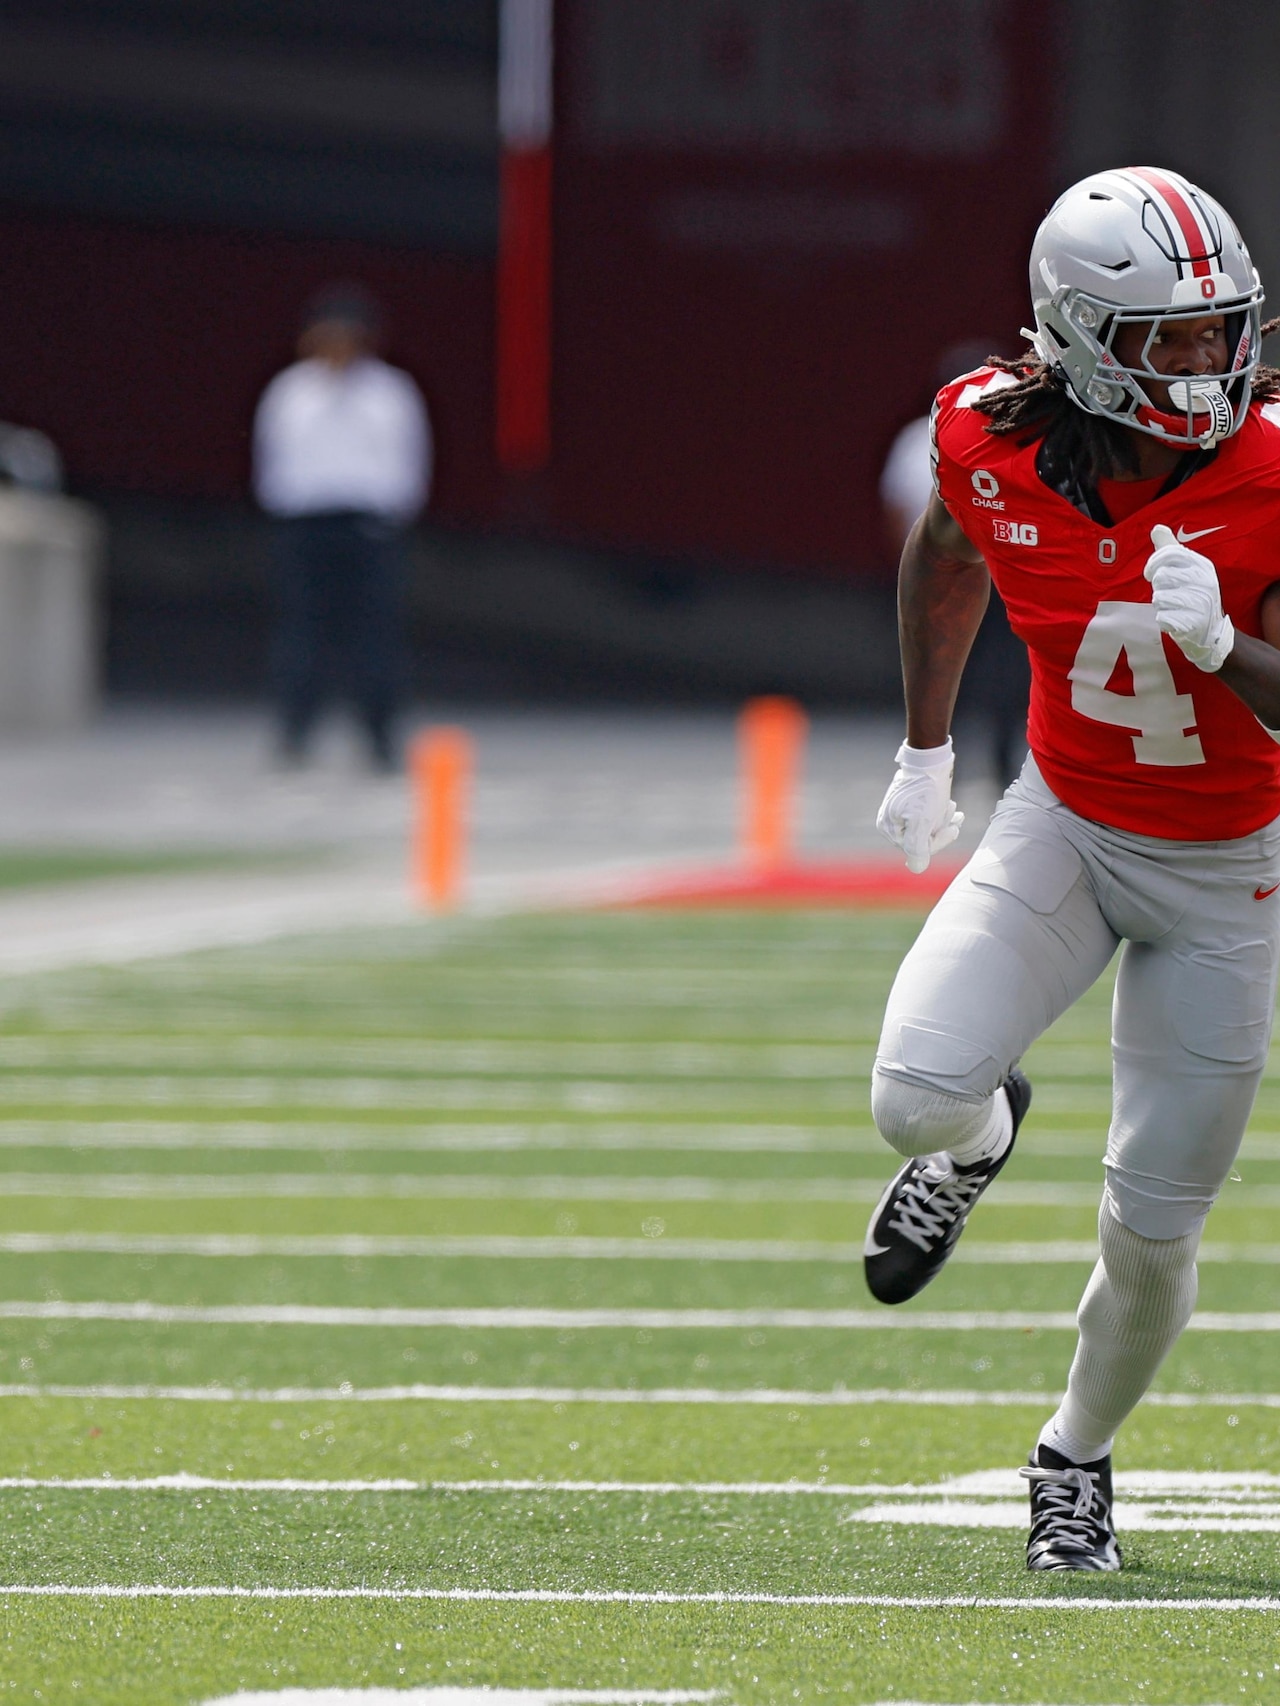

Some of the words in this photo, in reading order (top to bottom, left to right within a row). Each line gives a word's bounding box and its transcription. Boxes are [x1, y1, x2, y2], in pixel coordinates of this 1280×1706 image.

[1200, 278, 1216, 299] O
[972, 497, 1006, 511] CHASE
[1067, 601, 1207, 767] 4
